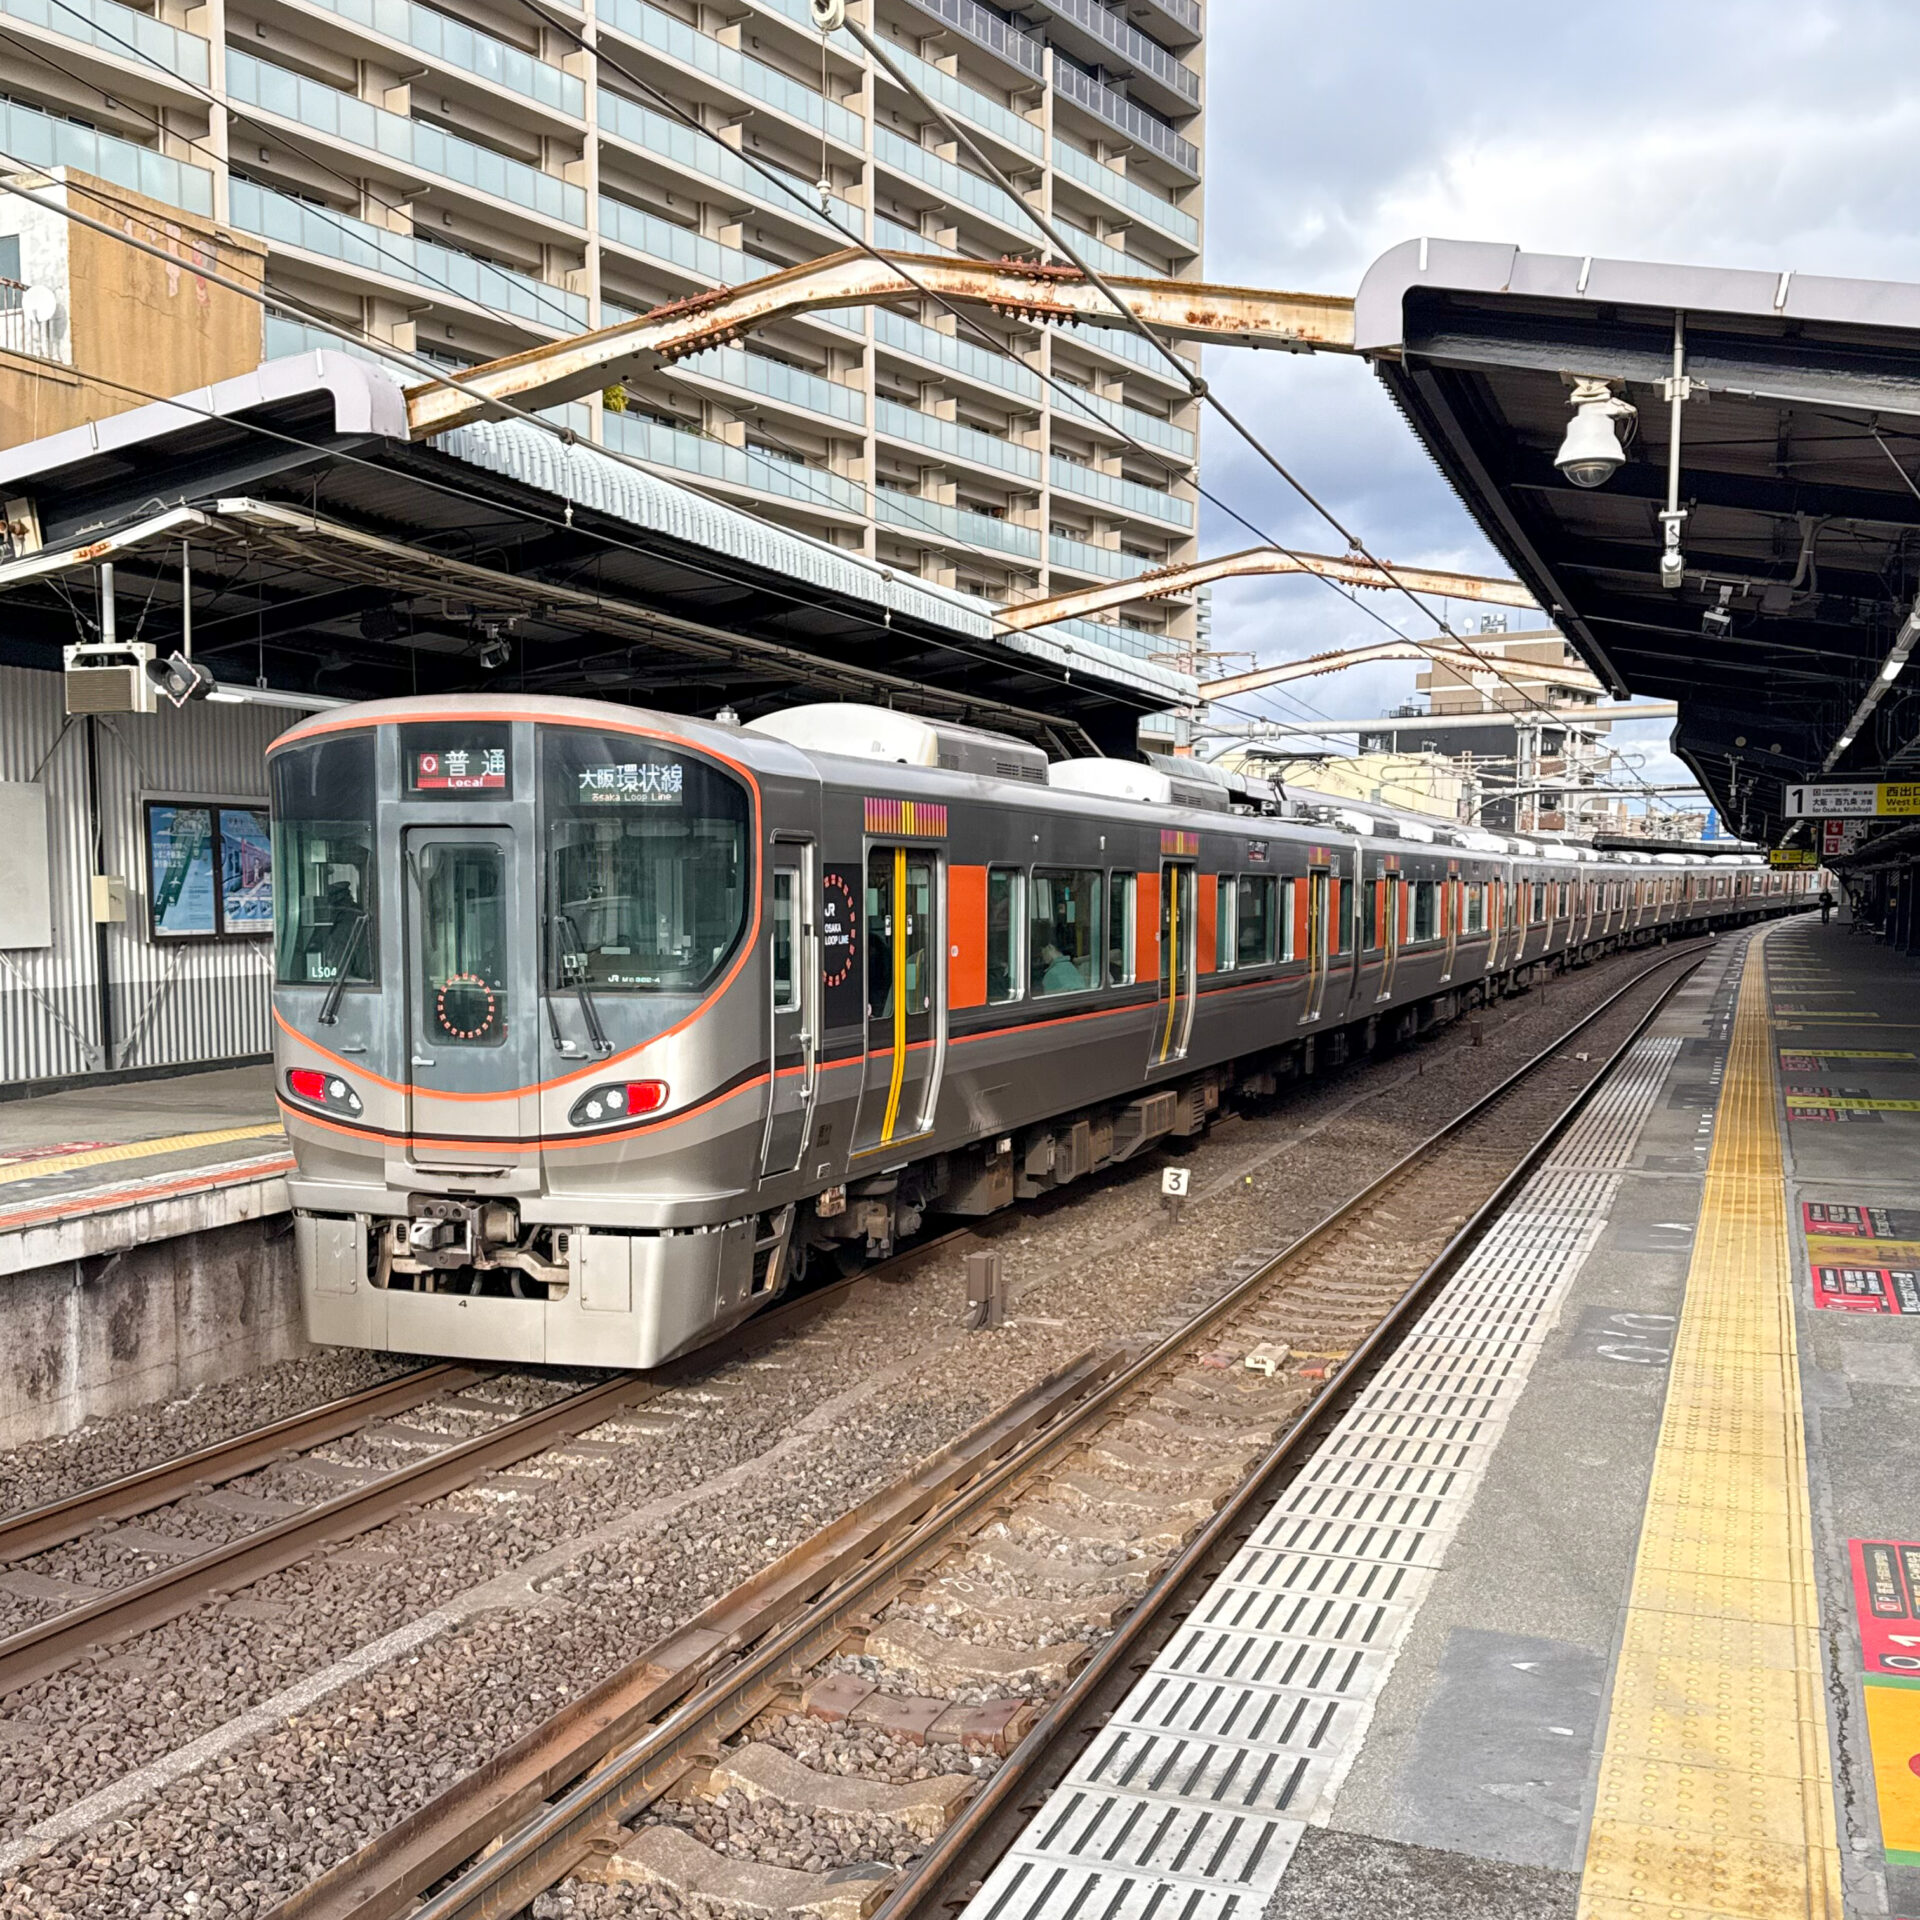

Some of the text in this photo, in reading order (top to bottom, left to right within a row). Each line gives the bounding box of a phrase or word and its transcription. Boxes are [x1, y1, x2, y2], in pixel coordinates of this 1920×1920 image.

[444, 749, 505, 776] 普通
[447, 777, 484, 787] Local
[578, 763, 682, 792] 大阪環状線
[624, 793, 647, 802] Loop
[651, 793, 672, 801] Line
[1792, 788, 1804, 814] 1
[1886, 798, 1911, 806] West
[825, 903, 835, 917] JR
[825, 923, 841, 933] OSAKA
[825, 934, 849, 945] LOOP LINE
[311, 966, 337, 978] LS04
[1168, 1172, 1182, 1191] 3
[458, 1299, 468, 1308] 4
